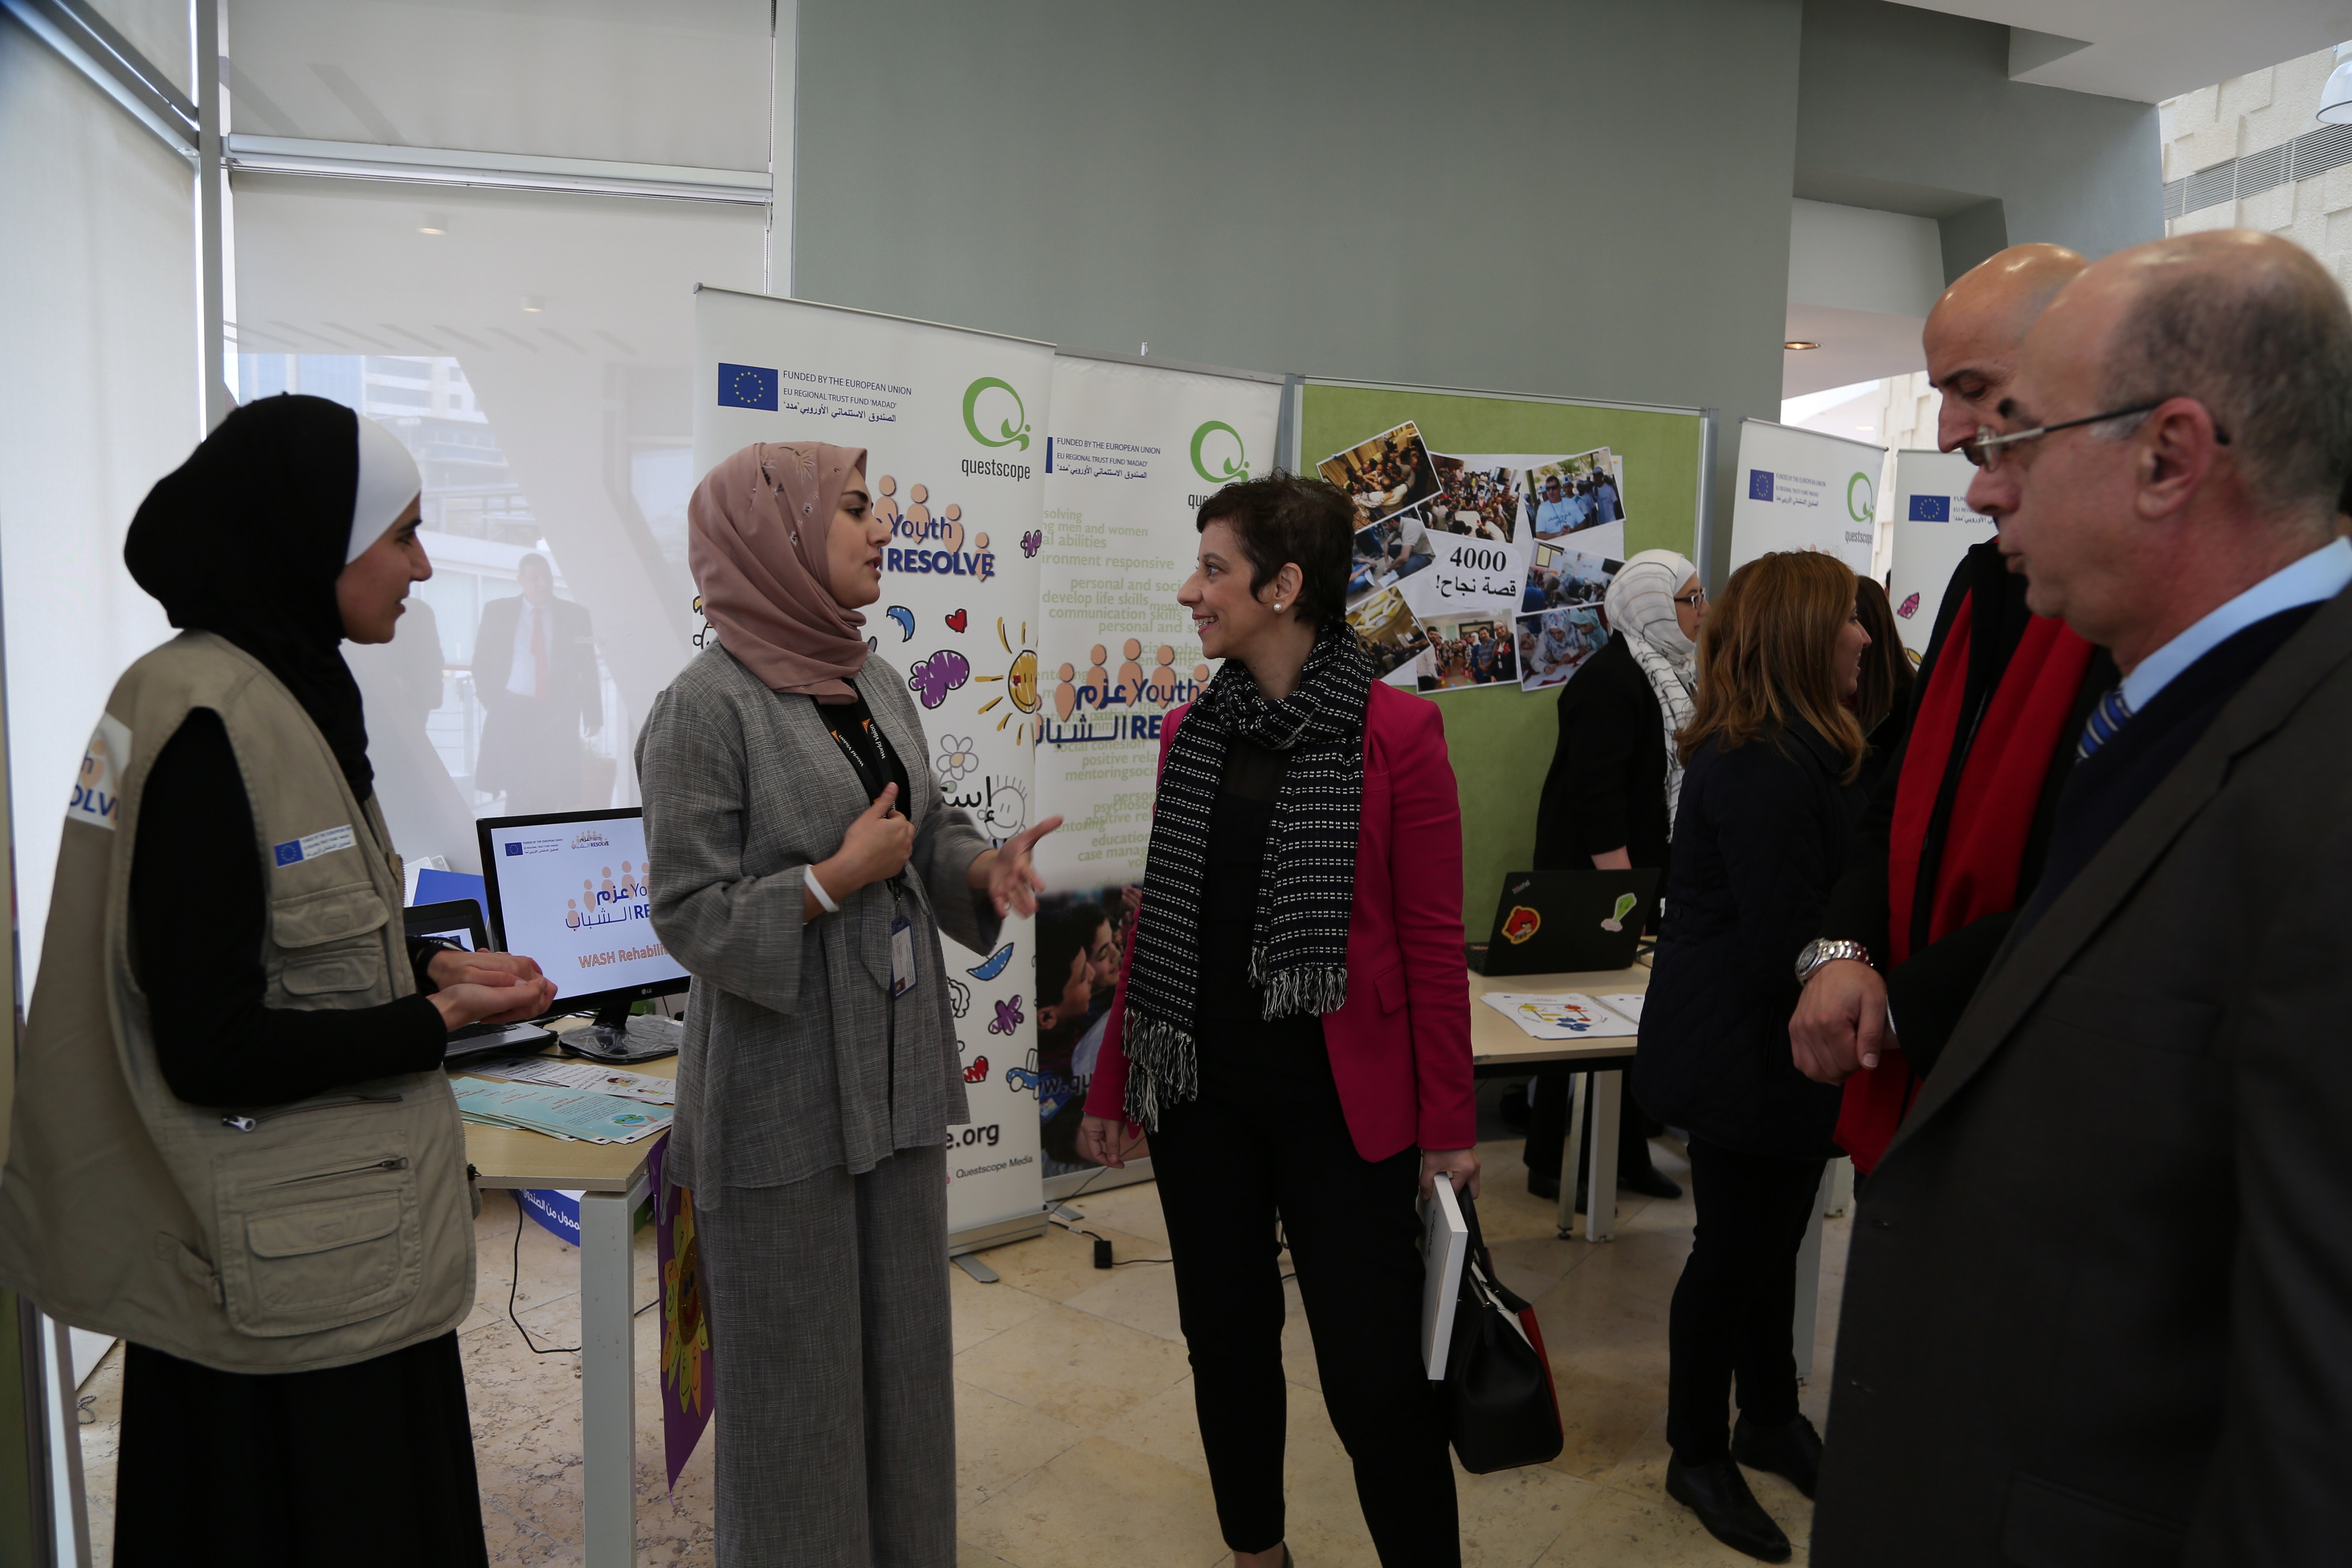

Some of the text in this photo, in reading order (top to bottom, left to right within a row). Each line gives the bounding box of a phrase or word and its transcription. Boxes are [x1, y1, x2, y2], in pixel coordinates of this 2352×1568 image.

[784, 371, 911, 395] FUNDED BY THE EUROPEAN UNION
[794, 389, 827, 400] REGIONAL
[828, 394, 848, 402] TRUST
[851, 396, 869, 405] FUND
[800, 404, 828, 415] الأوروبي
[831, 407, 866, 418] الاستئماني
[869, 414, 896, 422] الصندوق
[1057, 438, 1083, 446] FUNDED
[1106, 442, 1139, 452] EUROPEAN
[1066, 454, 1091, 462] REGIONAL
[962, 459, 1030, 482] questscope
[1044, 508, 1082, 523] solving
[887, 513, 952, 539] Youth
[1058, 523, 1081, 532] men
[1085, 523, 1104, 534] and
[1108, 526, 1148, 536] women
[1043, 532, 1107, 548] al abilities
[1845, 530, 1872, 546] questscope
[887, 548, 995, 575] RESOLVE
[1042, 551, 1174, 571] ironment responsive
[1450, 546, 1506, 572] 4000
[1071, 578, 1183, 591] personal and soci
[1436, 574, 1515, 598] قصة نجاح!
[1042, 590, 1149, 607] develop life skills
[1049, 607, 1182, 621] communication skills
[1150, 602, 1192, 612] mentor
[1099, 620, 1153, 635] personal
[1158, 621, 1182, 632] and
[1076, 678, 1126, 710] عزم
[1132, 678, 1200, 702] Youth
[869, 724, 886, 759] World Vision
[839, 735, 863, 767] World Vision
[1082, 751, 1157, 769] positive rela
[1114, 792, 1156, 804] person
[1094, 800, 1153, 816] psychoso
[1054, 818, 1106, 833] entoring
[1078, 846, 1148, 861] case manag
[597, 886, 629, 905] عزم
[565, 906, 632, 931] الشباب
[578, 943, 669, 968] WASH Rehabilit
[956, 1156, 1033, 1178] Questscope Media
